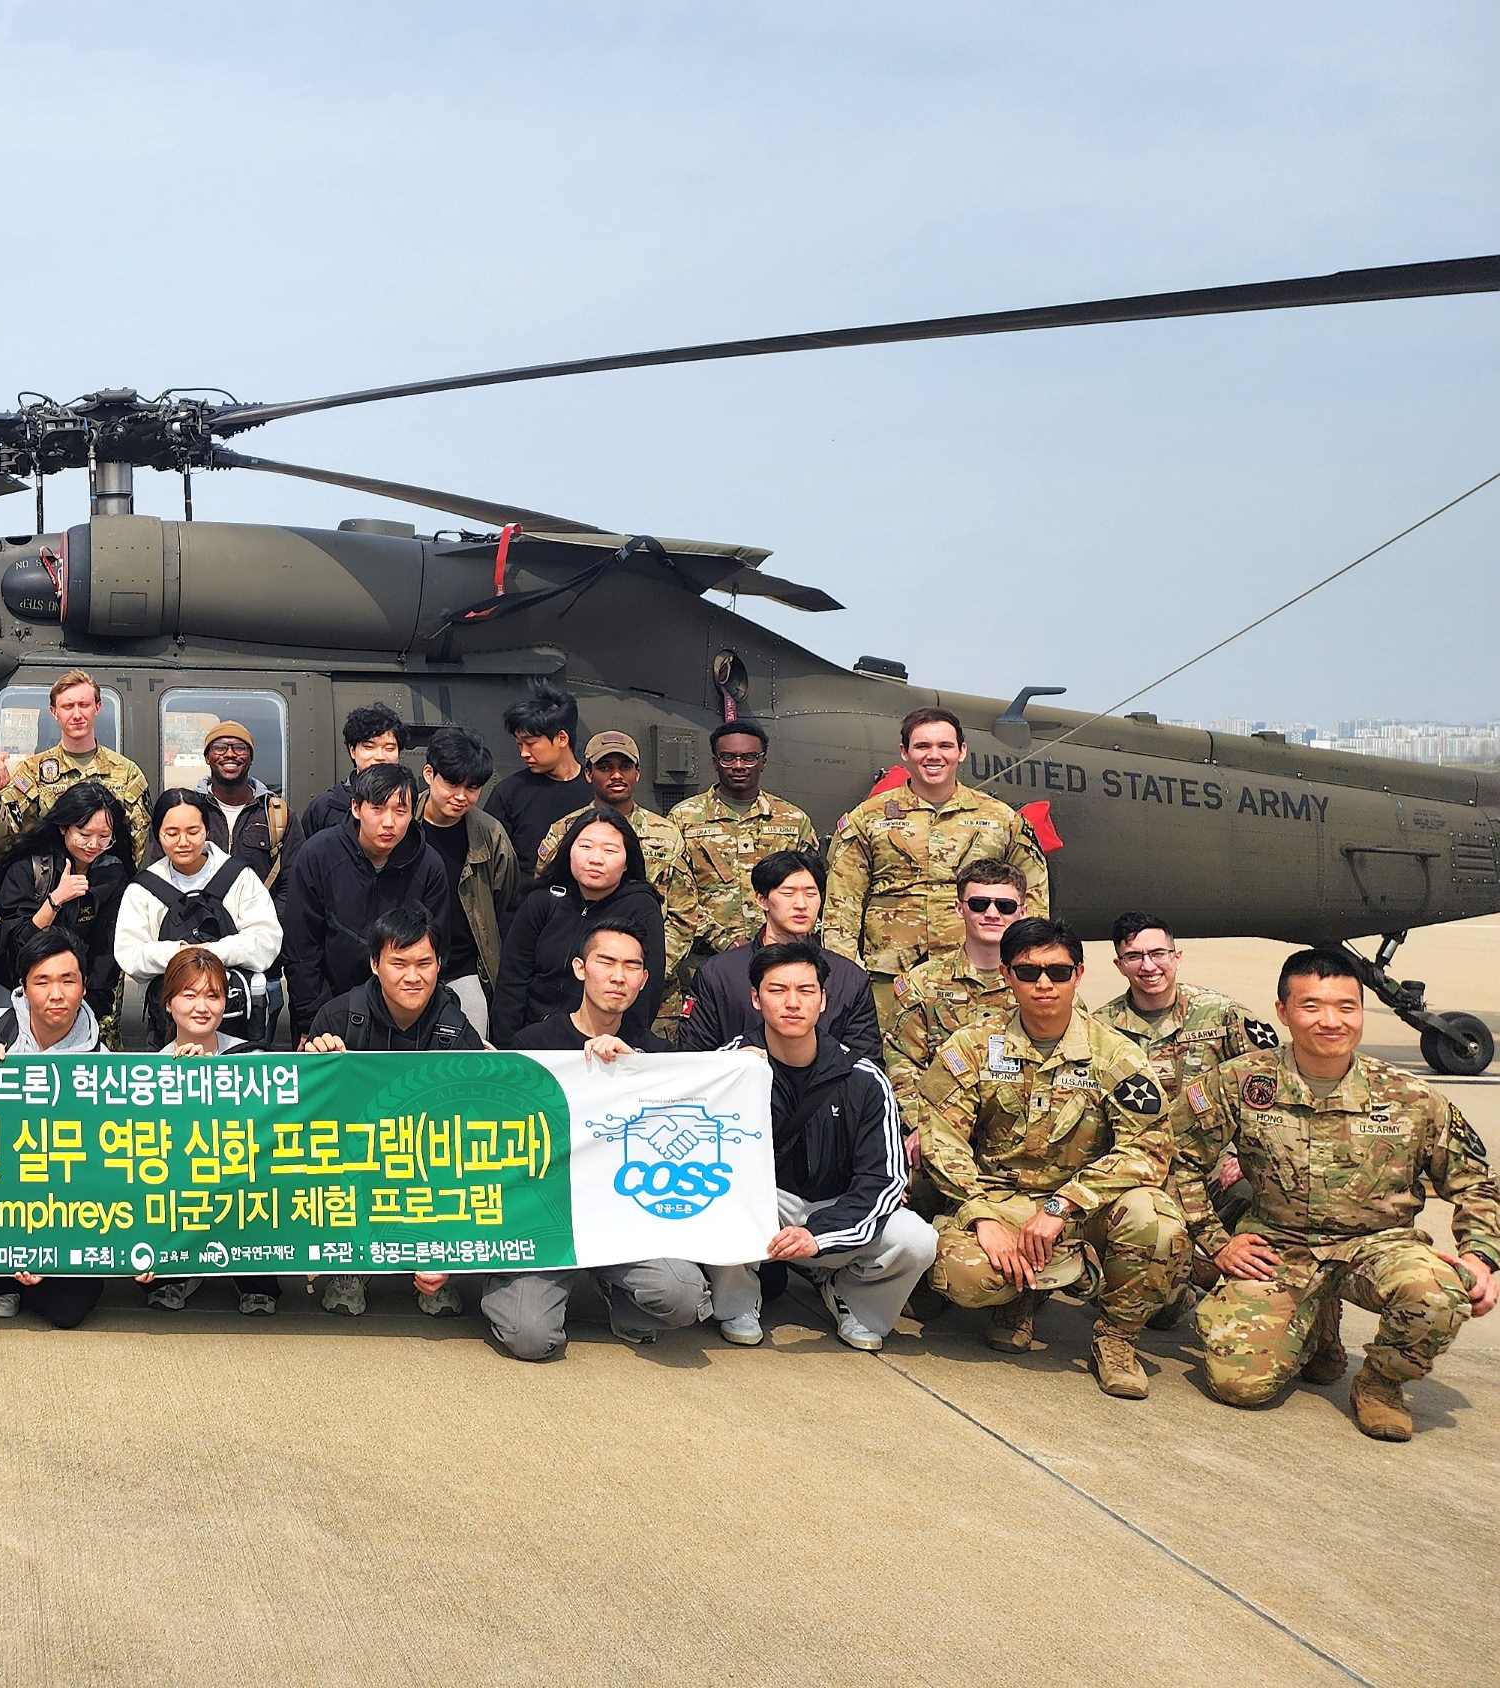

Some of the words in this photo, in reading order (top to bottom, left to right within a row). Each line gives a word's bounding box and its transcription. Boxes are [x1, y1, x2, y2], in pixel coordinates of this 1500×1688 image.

[15, 560, 29, 570] NO
[970, 752, 1088, 793] UNITED
[1102, 769, 1224, 810] STATES
[1237, 786, 1330, 823] ARMY
[72, 1064, 299, 1106] 혁신융합대학사업
[991, 1072, 1017, 1081] HONG
[1256, 1113, 1284, 1124] HONG
[13, 1118, 86, 1184] 실무
[99, 1118, 173, 1184] 역량
[184, 1119, 260, 1183] 심화
[270, 1111, 551, 1182] 프로그램(비교과)
[613, 1161, 734, 1197] COSS
[145, 1187, 279, 1232] 미군기지
[291, 1184, 357, 1228] 체험
[369, 1183, 503, 1225] 프로그램
[159, 1250, 190, 1263] 교육부
[230, 1245, 295, 1261] 한국연구재단
[369, 1239, 536, 1264] 항공드론혁신융합사업단
